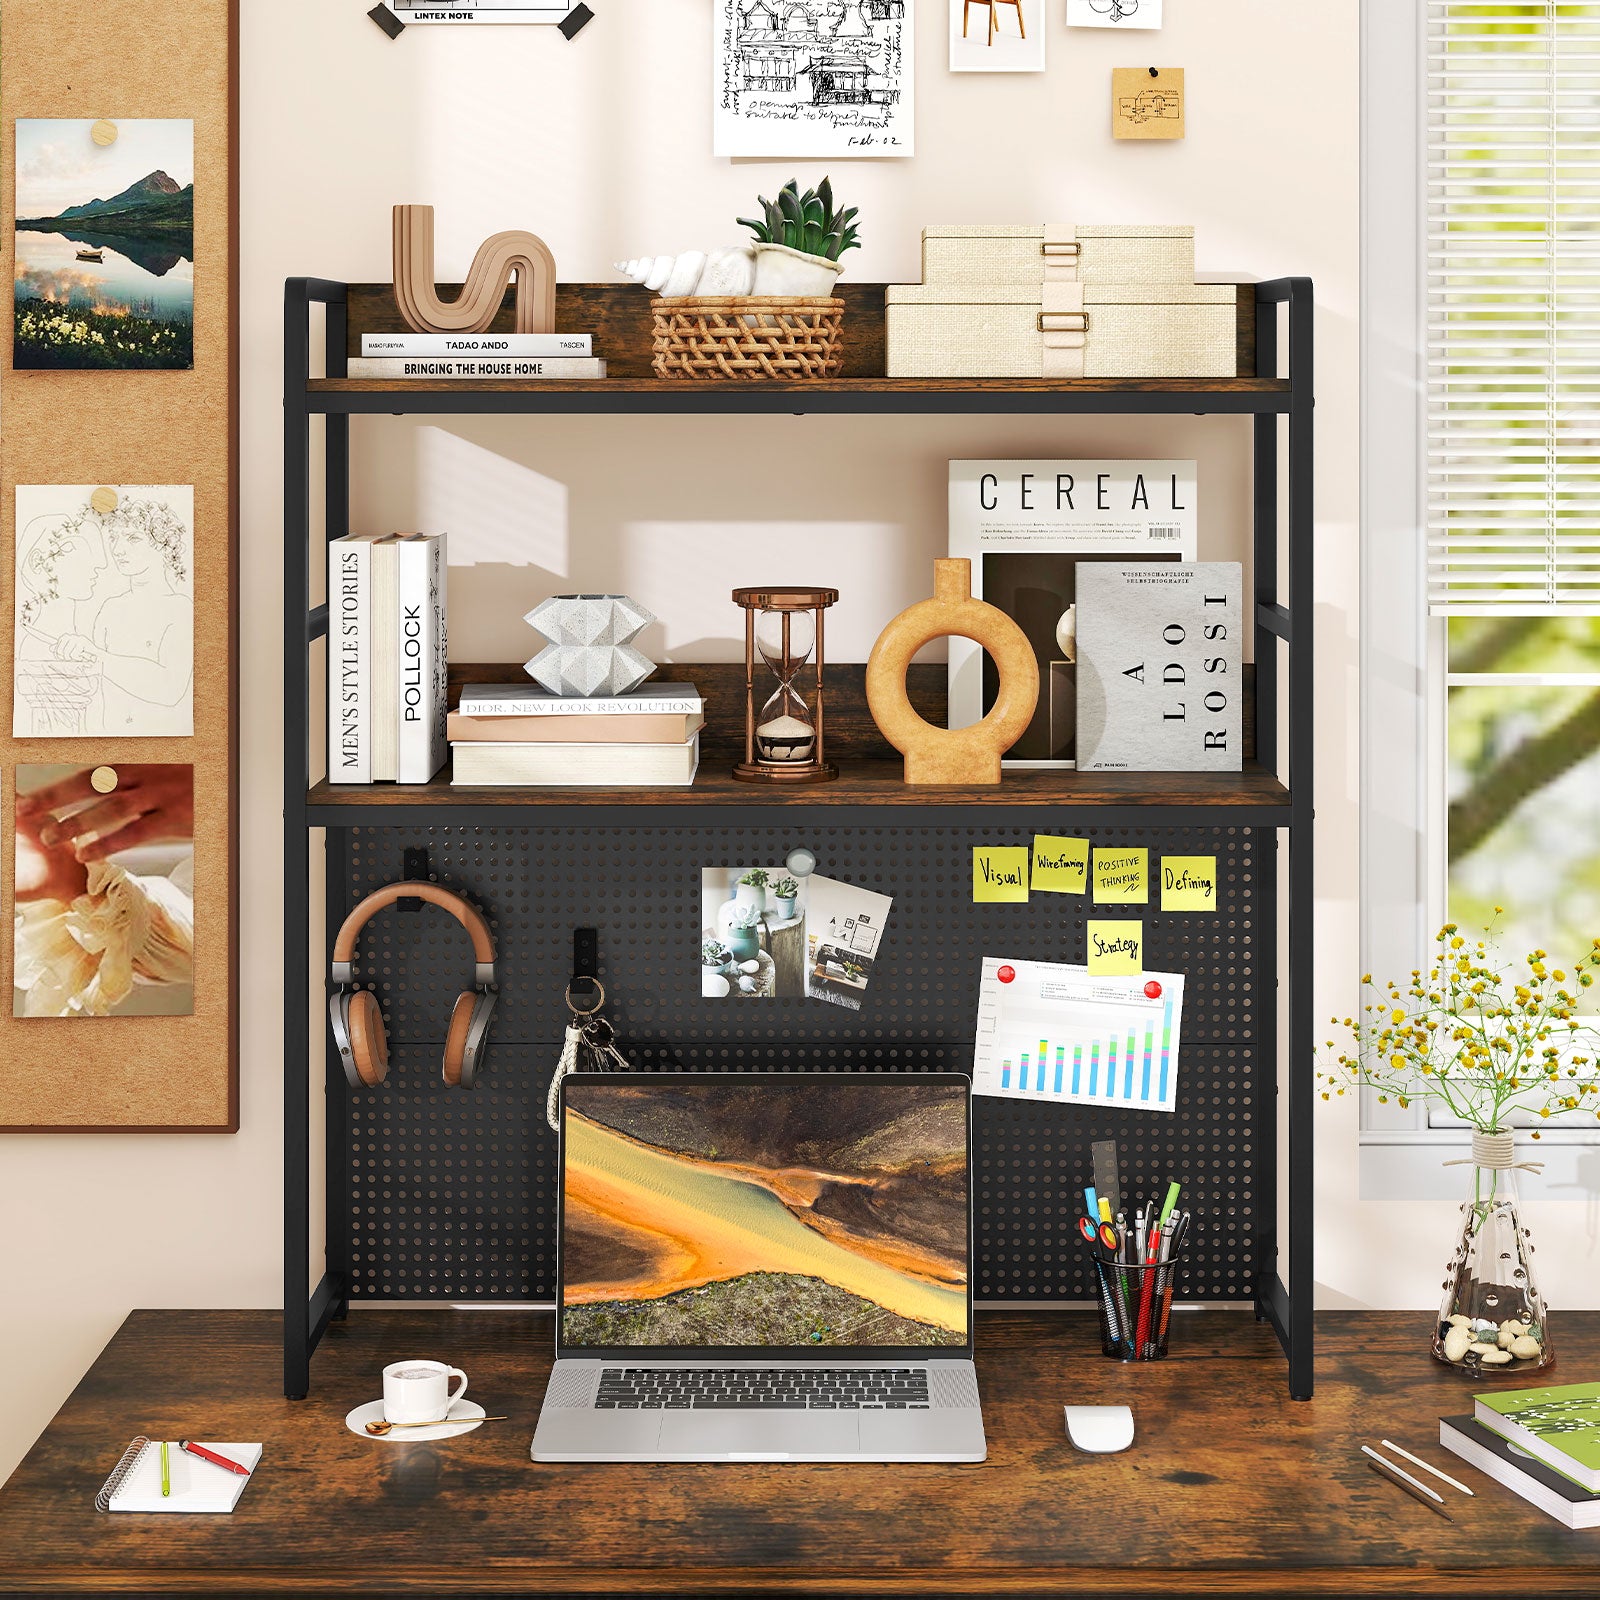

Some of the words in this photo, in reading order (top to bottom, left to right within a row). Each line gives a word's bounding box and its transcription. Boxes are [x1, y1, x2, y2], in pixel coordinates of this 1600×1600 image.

[414, 12, 447, 20] LINTEX
[448, 12, 474, 20] NOTE
[446, 341, 479, 349] TADAO
[481, 341, 509, 349] ANDO
[404, 363, 453, 375] BRINGING
[456, 363, 475, 375] THE
[478, 363, 512, 375] HOUSE
[514, 363, 543, 375] HOME
[980, 474, 1185, 510] CEREAL
[342, 552, 359, 637] STORIES
[342, 640, 359, 703] STYLE
[404, 605, 421, 722] POLLOCK
[1122, 662, 1144, 685] A
[1163, 624, 1185, 723] LDO
[1204, 595, 1227, 752] ROSSI
[511, 704, 546, 713] NEW
[551, 703, 592, 712] LOOK
[597, 702, 694, 712] REVOLUTION
[980, 857, 1023, 886] Visual
[1037, 854, 1085, 875] Wireframing
[1098, 856, 1140, 871] POSITIVE
[1100, 873, 1140, 888] THINKING
[1165, 867, 1213, 897] Defining
[1093, 933, 1139, 960] Strategy
